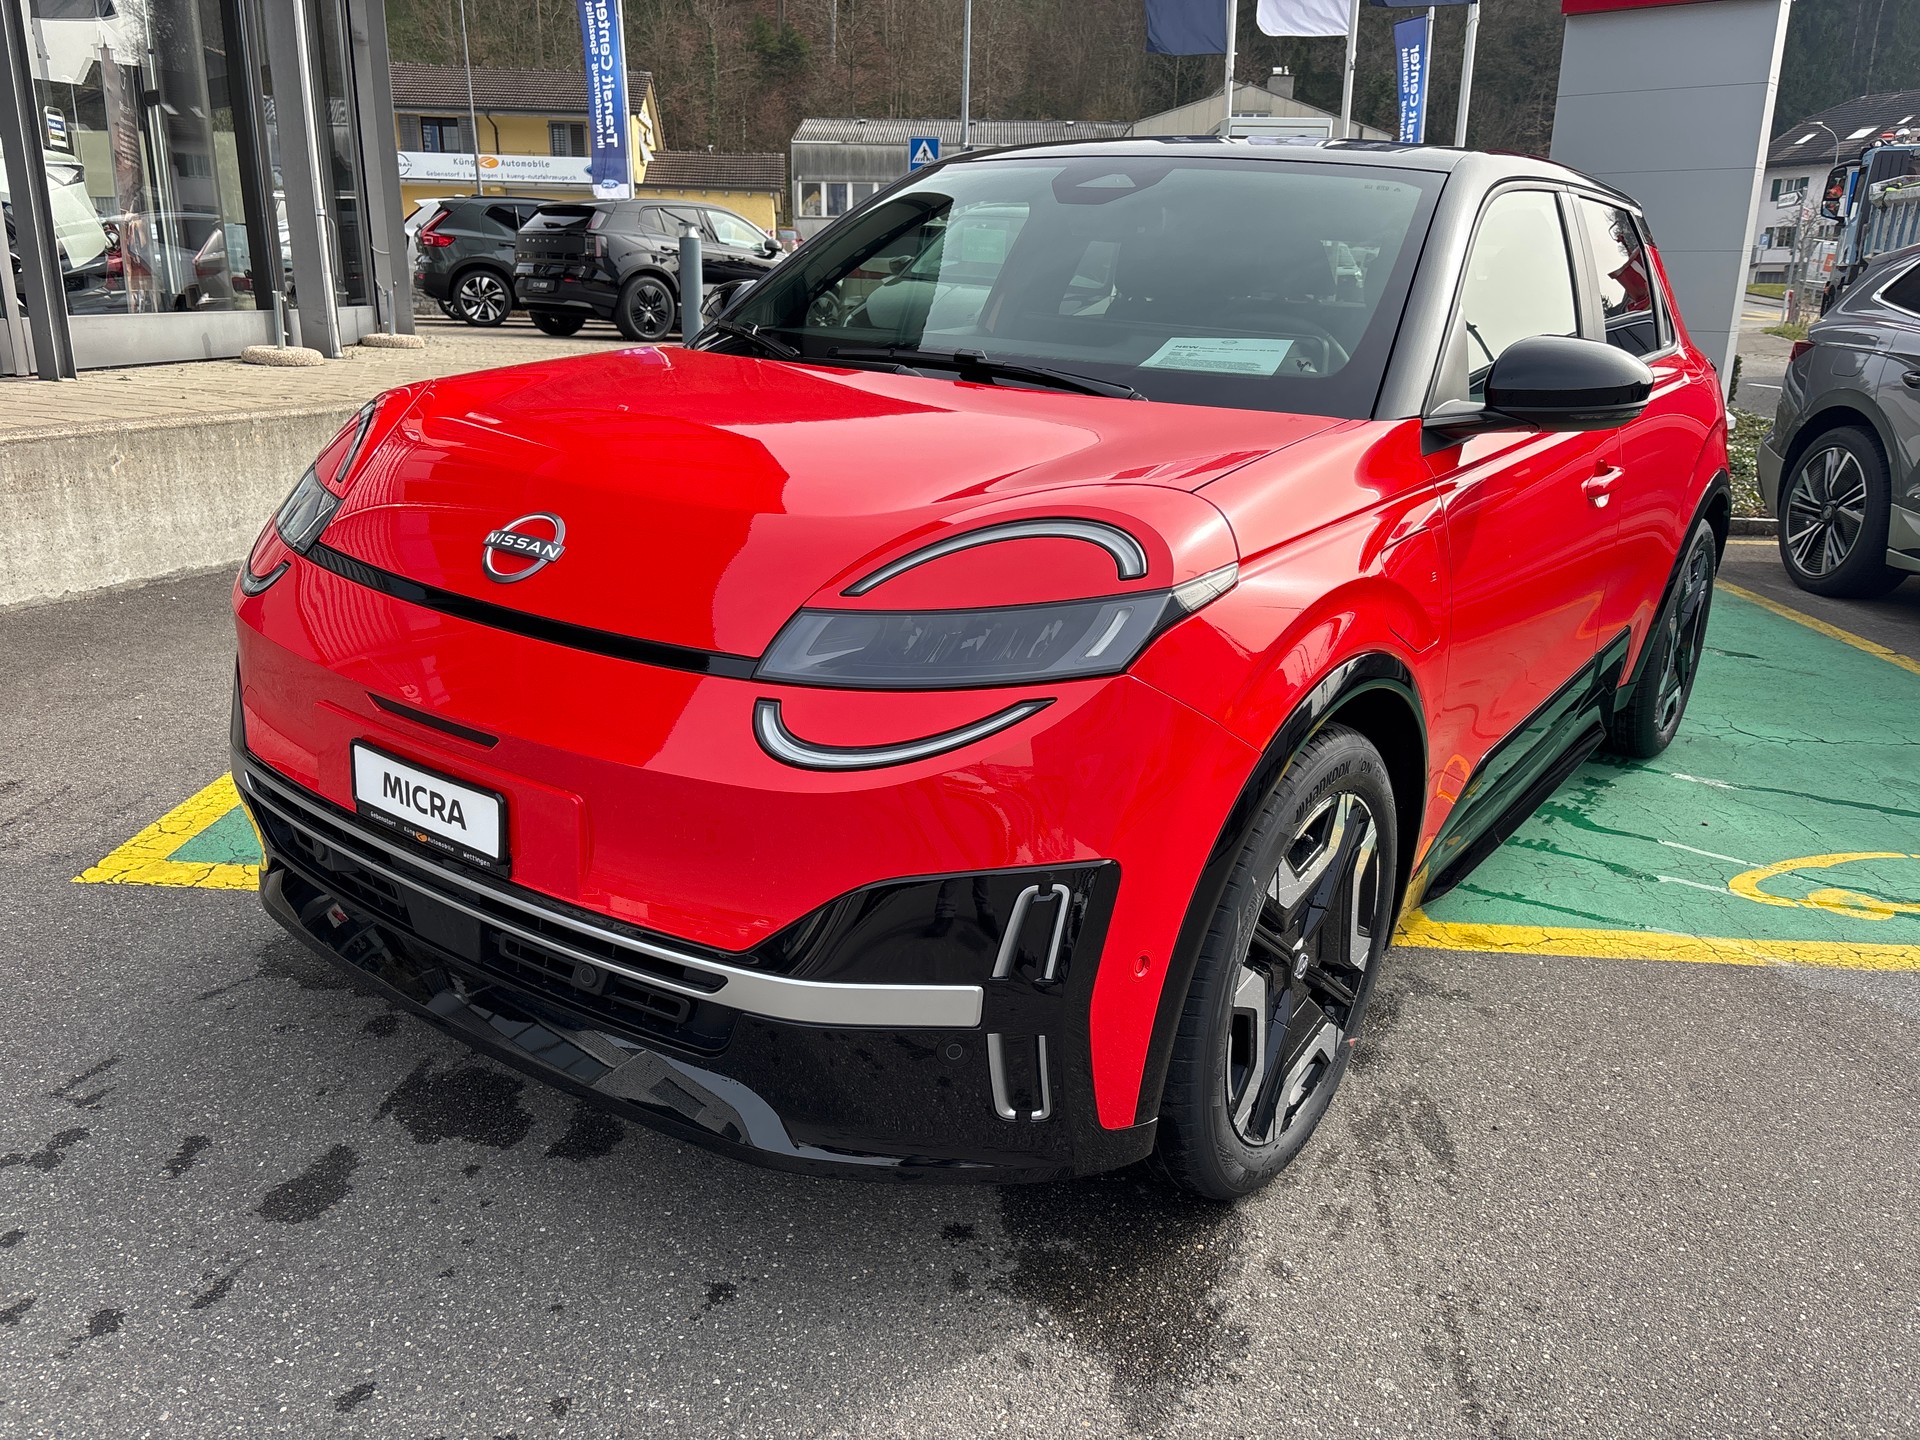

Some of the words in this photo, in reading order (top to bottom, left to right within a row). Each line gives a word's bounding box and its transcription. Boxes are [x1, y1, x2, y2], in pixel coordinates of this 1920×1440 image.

[500, 159, 550, 168] Automobile
[506, 173, 577, 181] kueng-nutzfahrzeuge.ch
[485, 532, 560, 558] NISSAN
[383, 771, 467, 831] MICRA
[370, 811, 397, 827] Gebenstorf
[403, 826, 416, 837] Küng
[428, 837, 454, 852] Automobile
[462, 852, 491, 867] Wettingen
